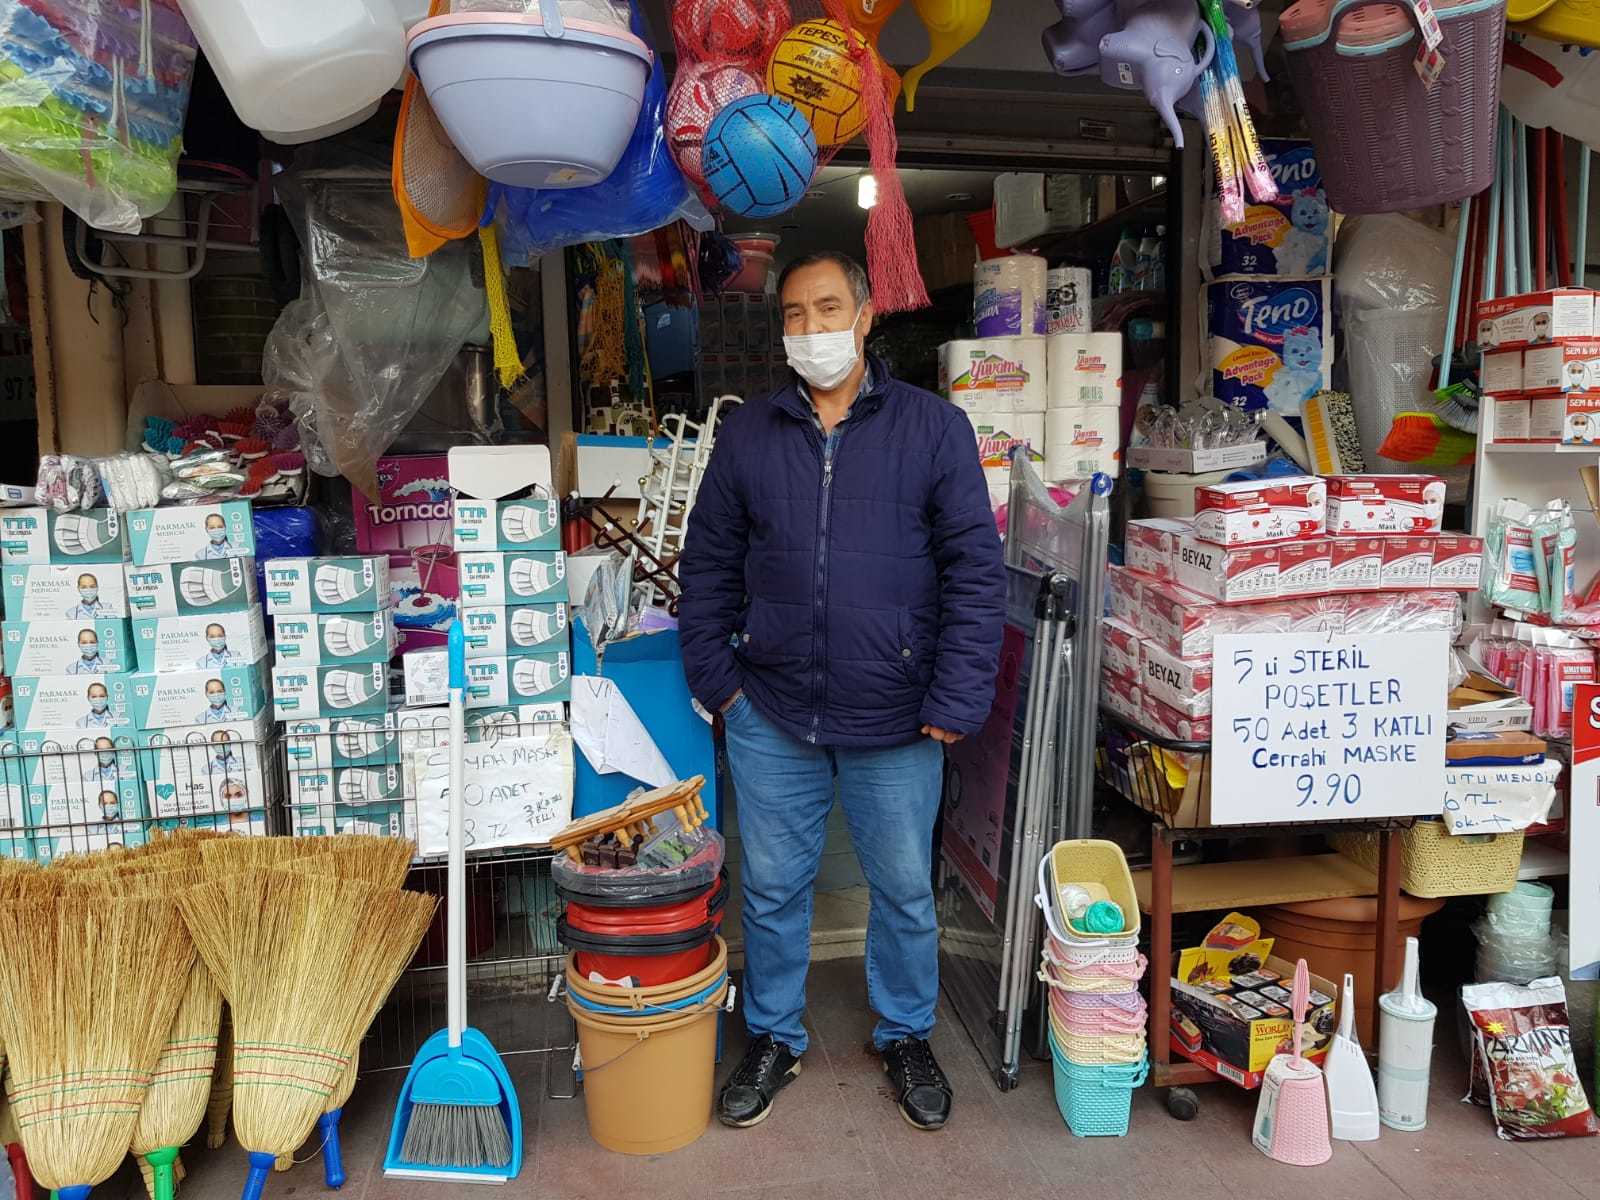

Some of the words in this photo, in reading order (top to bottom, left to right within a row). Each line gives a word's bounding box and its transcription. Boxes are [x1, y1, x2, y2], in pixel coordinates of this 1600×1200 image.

[1232, 216, 1285, 239] Advantage
[1251, 232, 1274, 245] Pack
[1241, 255, 1258, 267] 32
[1241, 295, 1310, 334] Teno
[969, 360, 1016, 388] Yuvam
[1222, 356, 1277, 380] Advantage
[1241, 372, 1265, 386] Pack
[1232, 396, 1247, 407] 32
[458, 506, 487, 518] TTR
[3, 517, 38, 529] TTR
[155, 521, 196, 531] PARMASK
[1266, 531, 1284, 539] Mask
[1182, 547, 1213, 571] BEYAZ
[465, 561, 495, 573] TTR
[128, 572, 164, 585] TTR
[268, 569, 300, 581] TTR
[31, 580, 71, 588] PARMASK
[466, 613, 497, 625] TTR
[277, 622, 309, 634] TTR
[29, 635, 69, 643] PARMASK
[160, 631, 200, 640] PARMASK
[468, 663, 499, 675] TTR
[1233, 649, 1253, 684] 5
[276, 674, 308, 686] TTR
[1148, 660, 1182, 690] BEYAZ
[39, 690, 79, 698] PARMASK
[157, 686, 197, 696] PARMASK
[1233, 717, 1270, 743] 50
[1281, 719, 1330, 741] Adet
[1342, 712, 1358, 739] 3
[1374, 714, 1432, 738] KATLI
[1252, 747, 1326, 768] Cerrahi
[1344, 743, 1417, 765] MASKE
[299, 774, 329, 786] TTR
[489, 782, 530, 803] ADET
[1296, 773, 1361, 807] 9.90
[1444, 791, 1461, 812] 6
[523, 804, 535, 818] 3
